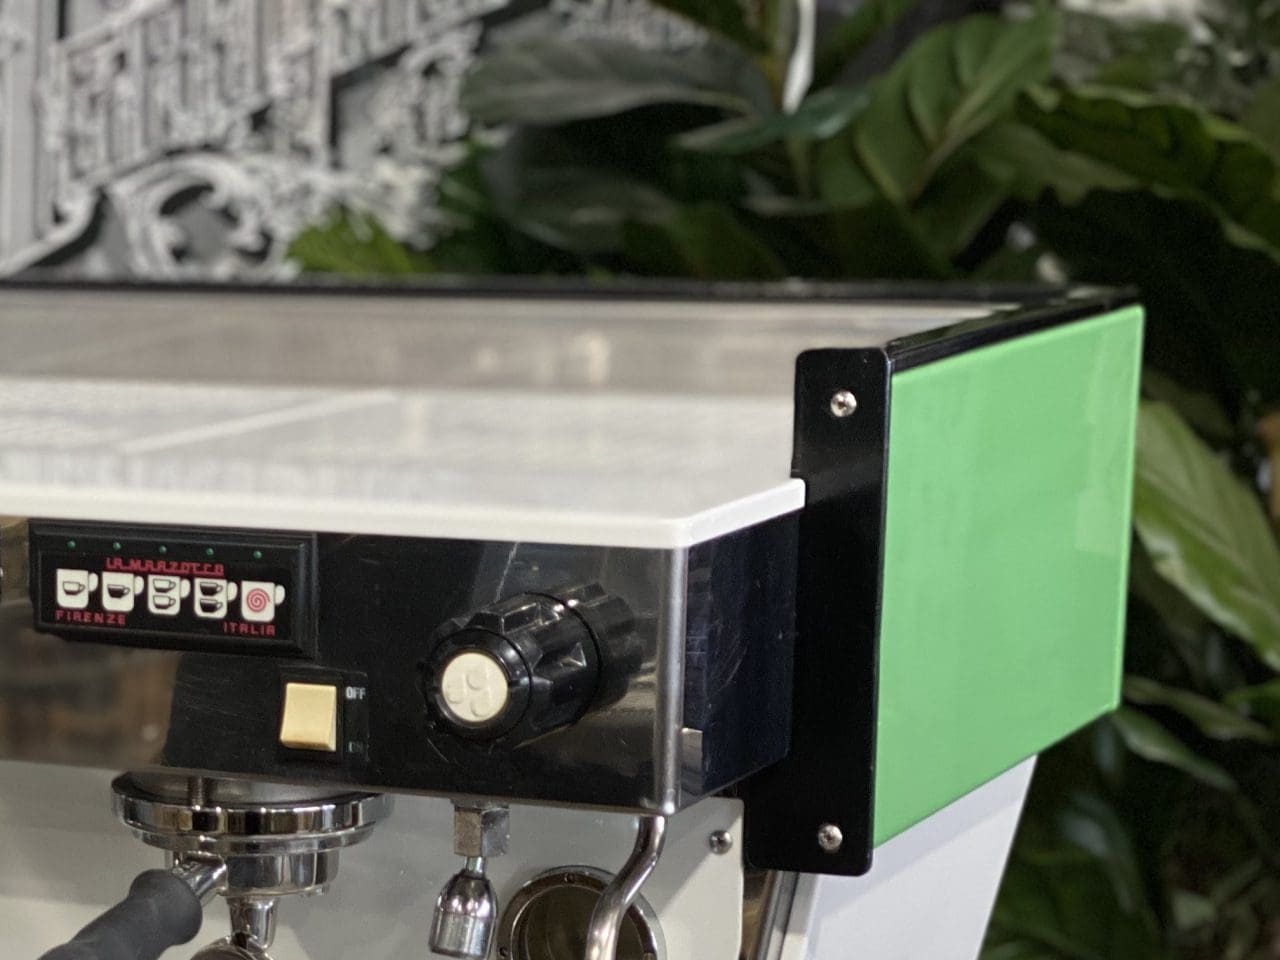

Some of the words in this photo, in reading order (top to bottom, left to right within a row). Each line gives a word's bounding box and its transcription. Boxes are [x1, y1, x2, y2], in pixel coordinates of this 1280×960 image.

[128, 558, 225, 577] MARZOCCO
[55, 610, 126, 626] FIRENZE
[224, 621, 276, 636] ITALIA
[346, 686, 366, 699] OFF
